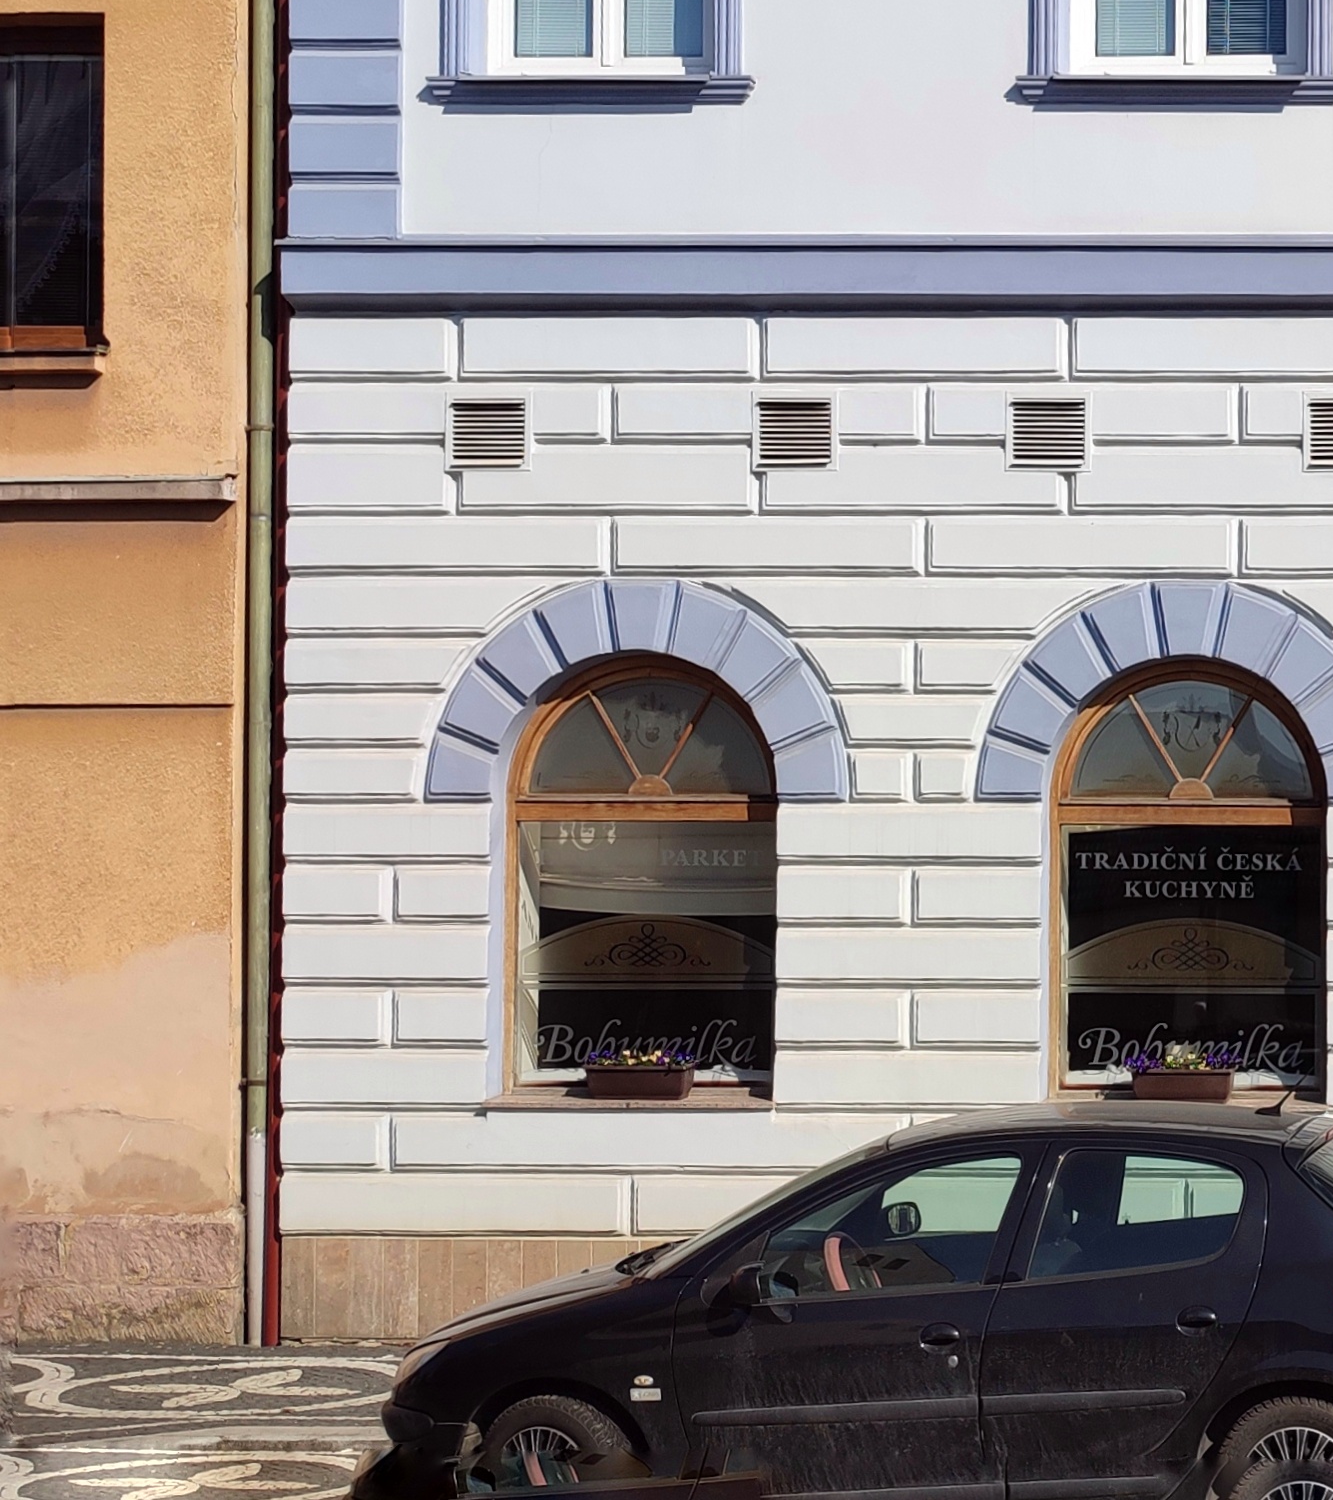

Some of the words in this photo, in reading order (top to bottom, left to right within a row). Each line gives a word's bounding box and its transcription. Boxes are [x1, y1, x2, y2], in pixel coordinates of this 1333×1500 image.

[661, 849, 761, 867] PARKET
[1075, 846, 1207, 870] TRADIČNÍ
[1216, 846, 1302, 871] ČESKÁ
[1124, 875, 1255, 898] KUCHYNĚ
[535, 1019, 758, 1069] Bohumilka
